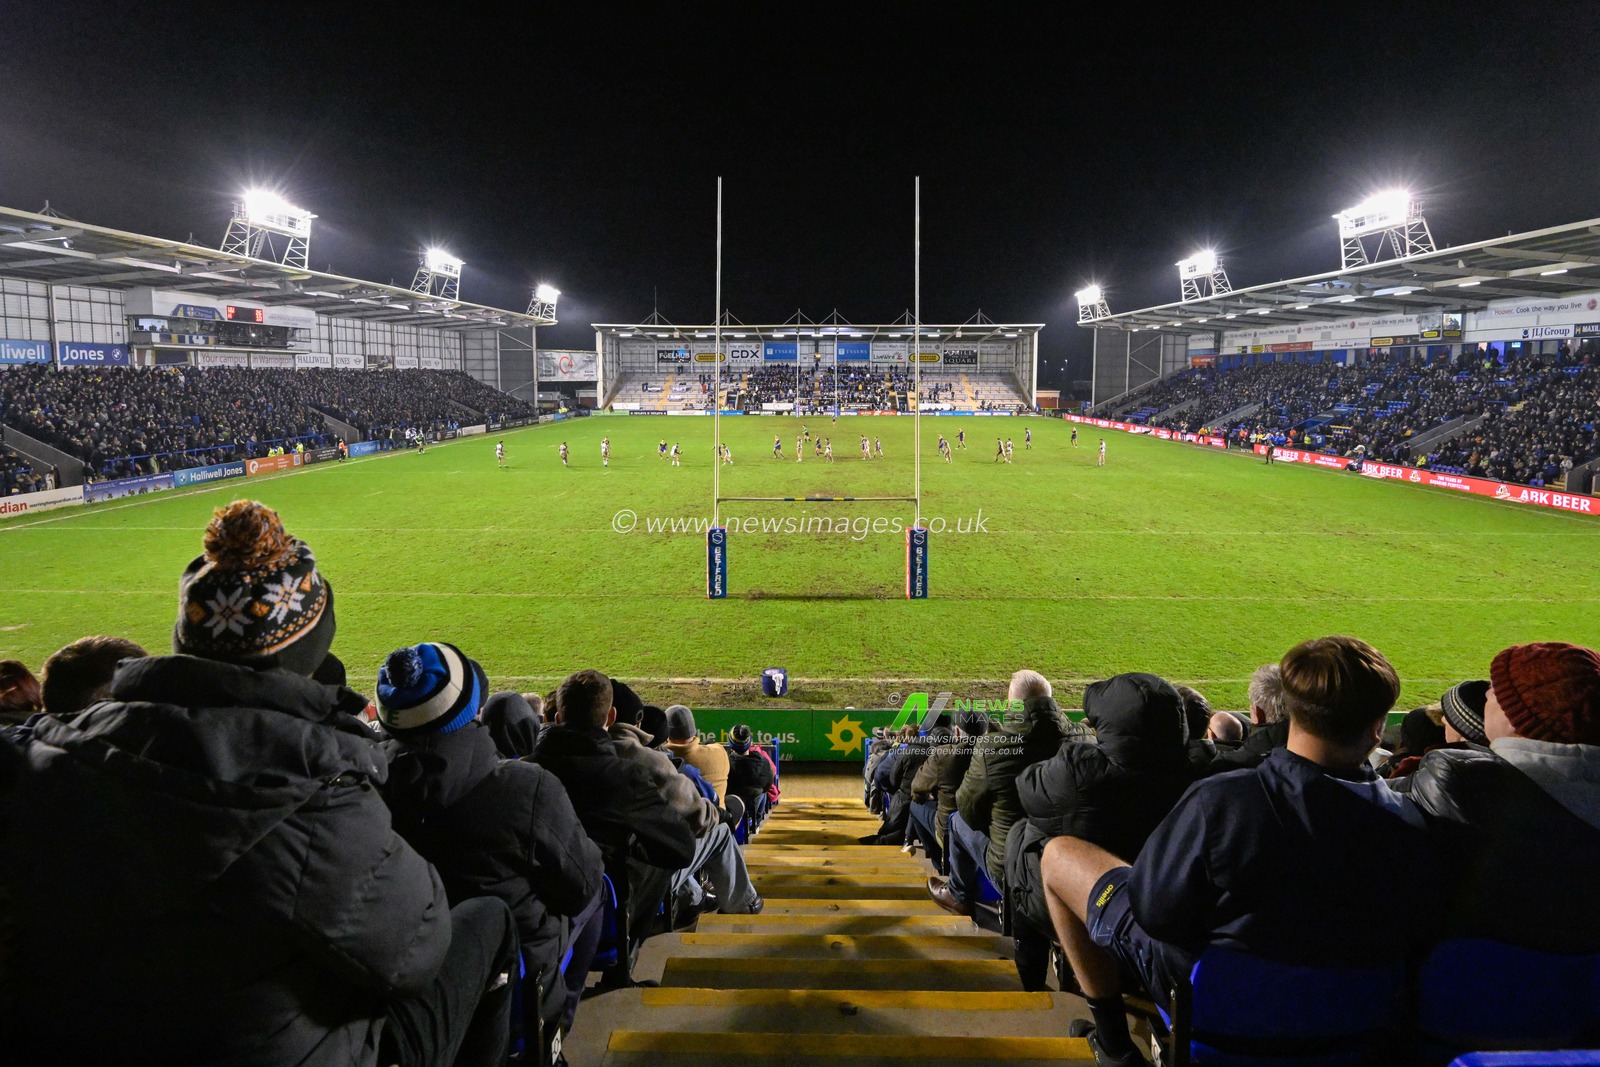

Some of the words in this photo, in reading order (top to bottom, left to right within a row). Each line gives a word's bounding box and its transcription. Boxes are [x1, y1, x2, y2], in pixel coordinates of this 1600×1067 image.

[62, 345, 104, 362] Jones
[200, 353, 218, 363] Your
[219, 354, 246, 366] campus
[259, 355, 293, 366] Warrington
[297, 354, 330, 364] HALLIWELL
[335, 356, 350, 365] JONES
[731, 350, 760, 358] CDX
[1273, 448, 1282, 456] BK
[1283, 450, 1298, 460] BEER
[190, 468, 222, 482] Halliwell
[224, 466, 243, 477] Jones
[1362, 462, 1378, 474] ABK
[1380, 466, 1402, 478] BEER
[0, 501, 28, 514] dian
[1520, 489, 1550, 504] ABK
[1552, 494, 1590, 512] BEER
[914, 546, 923, 597] BETFRED
[696, 728, 716, 742] he
[757, 730, 772, 744] to
